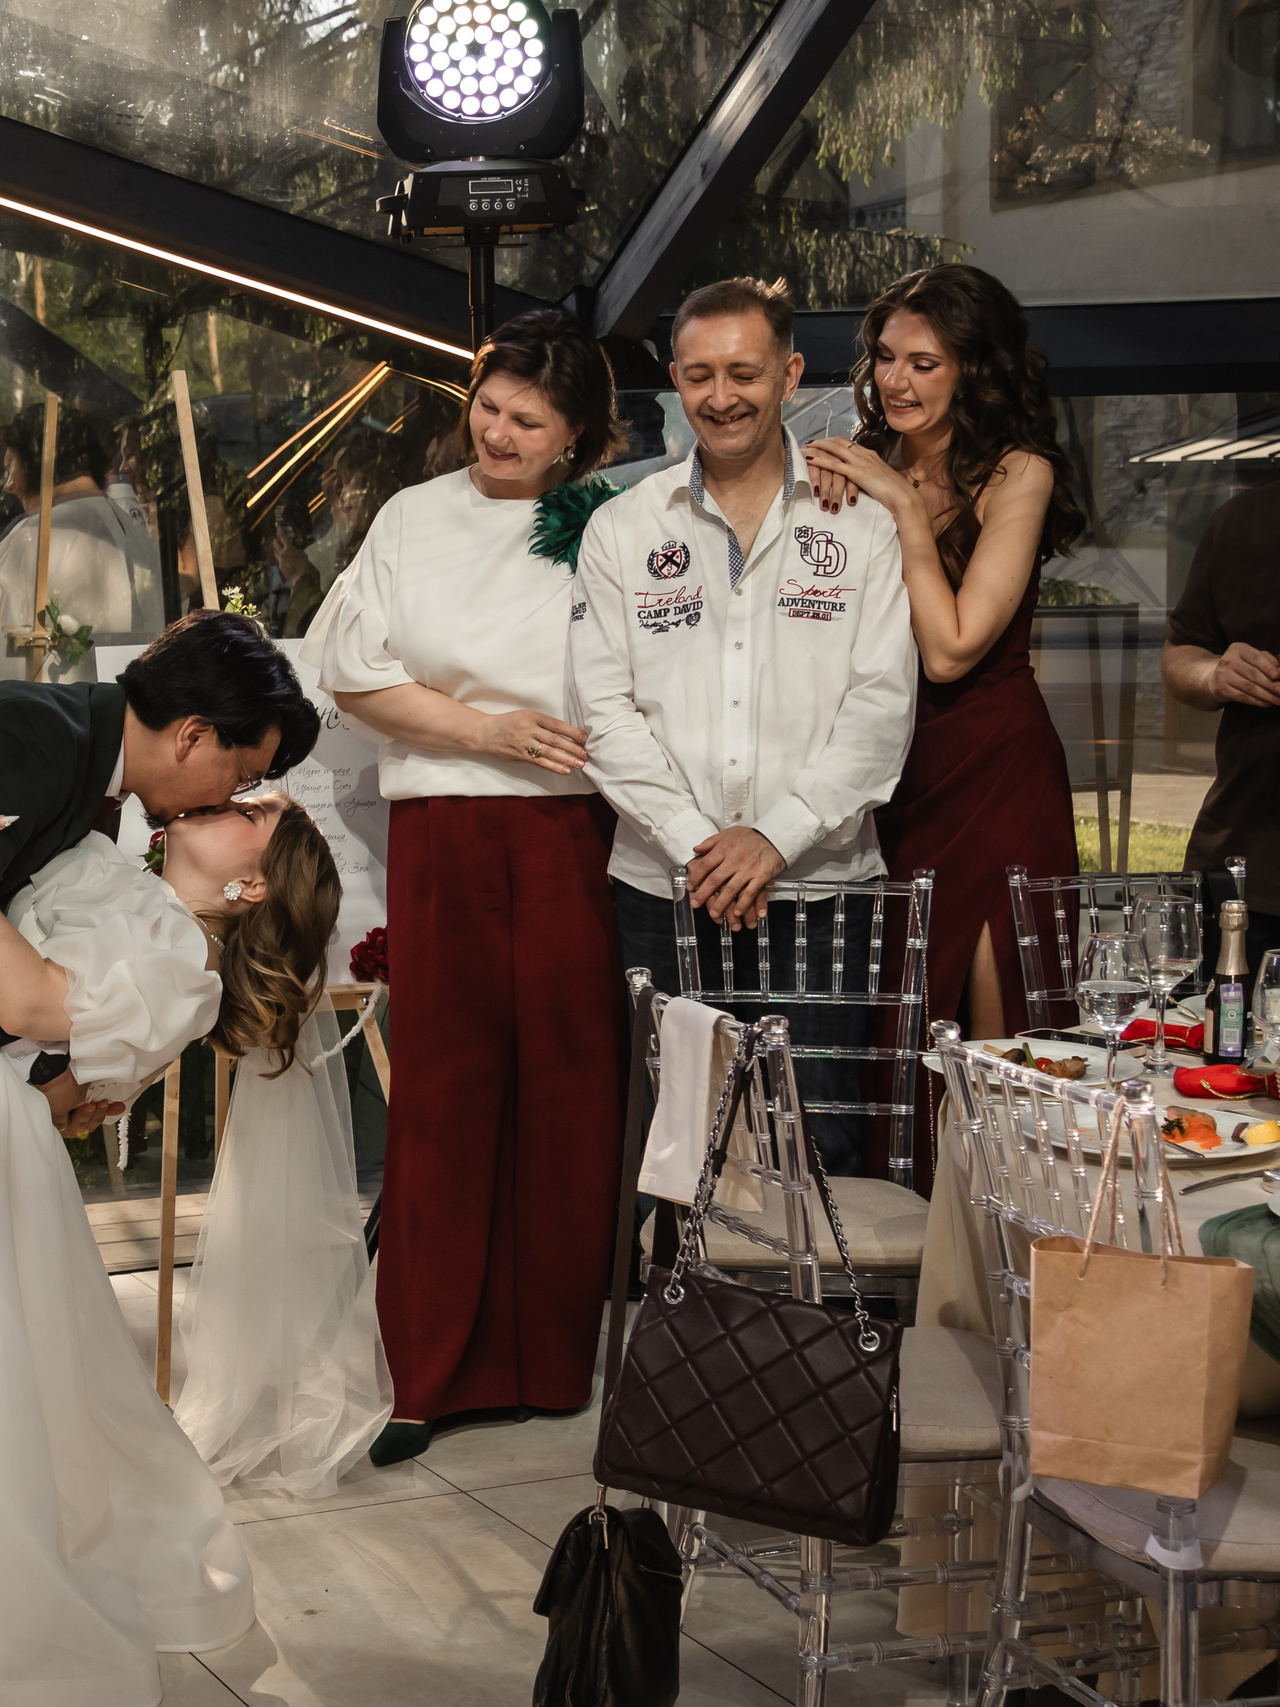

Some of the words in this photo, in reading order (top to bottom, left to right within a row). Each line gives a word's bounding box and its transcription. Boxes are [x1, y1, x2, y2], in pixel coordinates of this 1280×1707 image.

[797, 529, 809, 539] 25
[634, 585, 703, 609] Ireland
[778, 578, 857, 599] Sports
[637, 607, 671, 620] CAMP
[673, 600, 704, 616] DAVID
[777, 597, 847, 612] ADVENTURE
